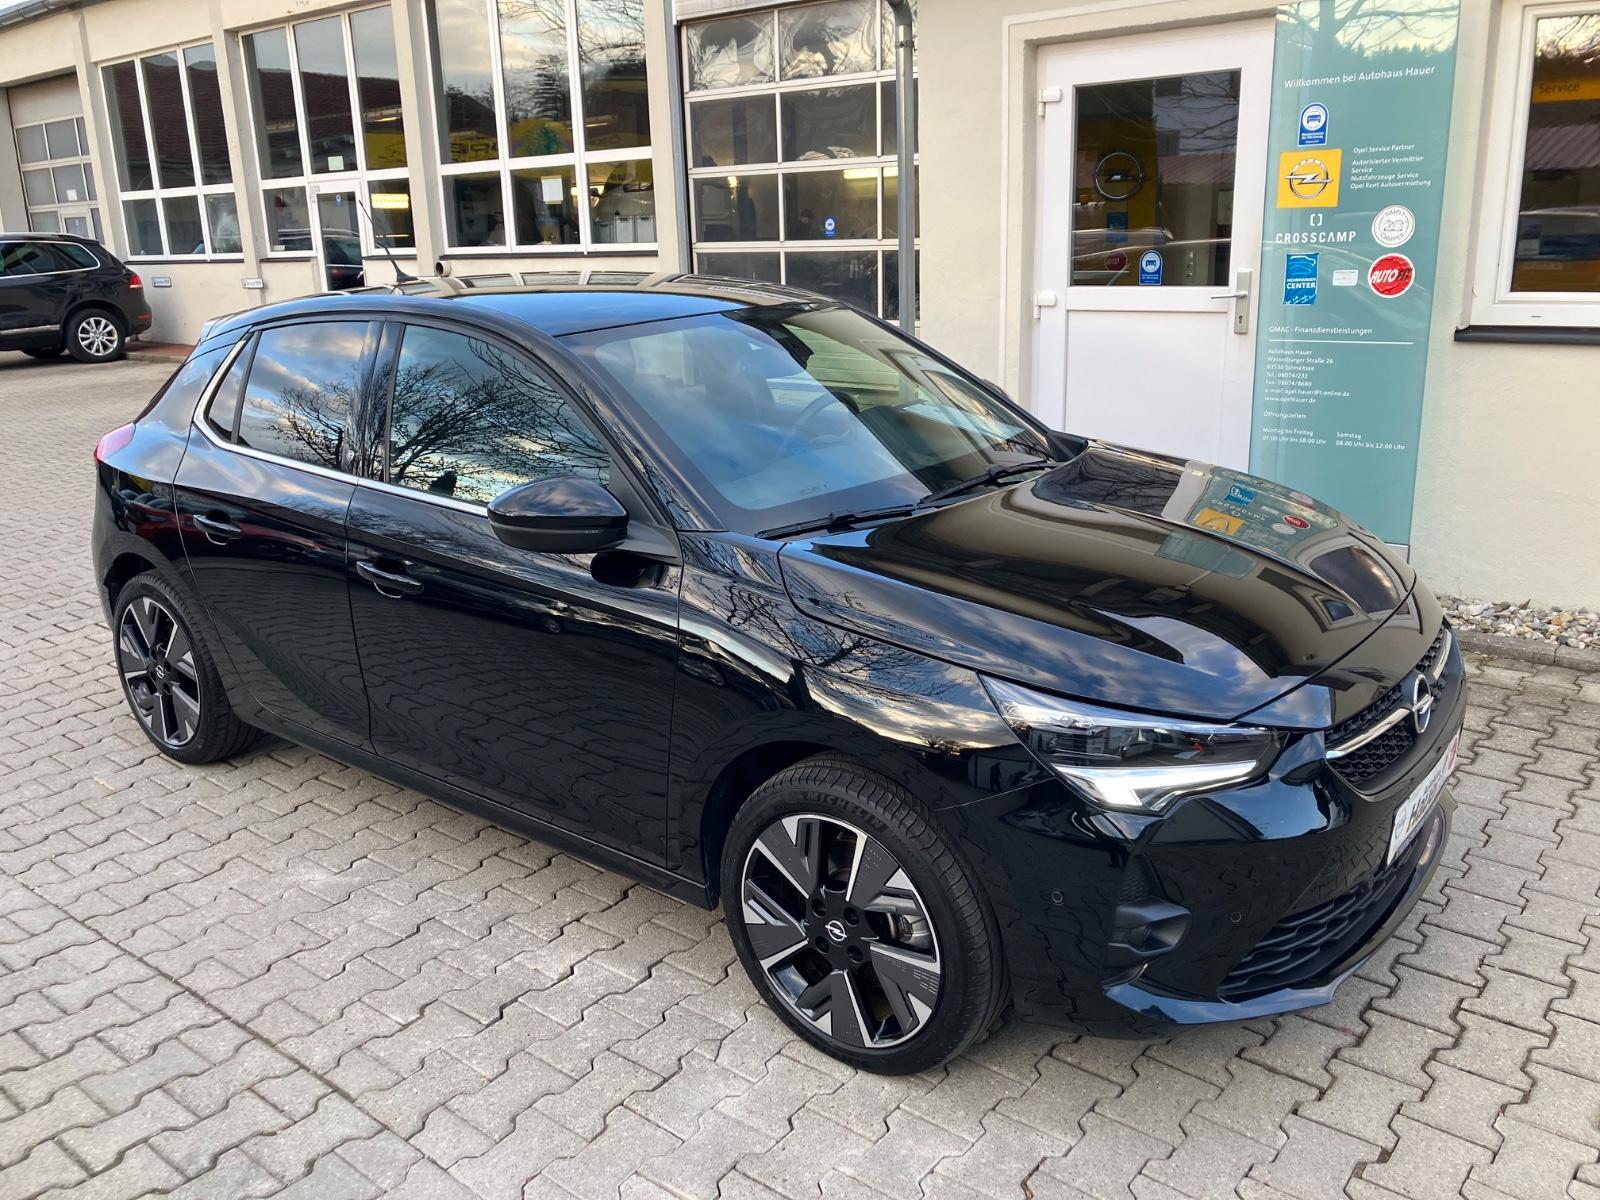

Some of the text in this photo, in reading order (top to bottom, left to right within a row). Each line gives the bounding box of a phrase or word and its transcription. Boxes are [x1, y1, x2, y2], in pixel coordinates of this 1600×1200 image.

[1284, 66, 1435, 89] Willkommen bei Autohaus Hauer
[1539, 83, 1580, 94] Service
[1391, 155, 1424, 163] Vermittler
[1350, 174, 1396, 182] Nutzfahrzeuge
[1380, 180, 1432, 188] Autovermietung
[1384, 208, 1406, 217] SIMPLY
[1275, 231, 1357, 243] CROSSCAMP
[1286, 281, 1316, 289] CENTER
[1294, 327, 1373, 336] Finanzdienstleistungen
[1336, 431, 1362, 440] Samstag
[806, 790, 888, 832] MICHELIN
